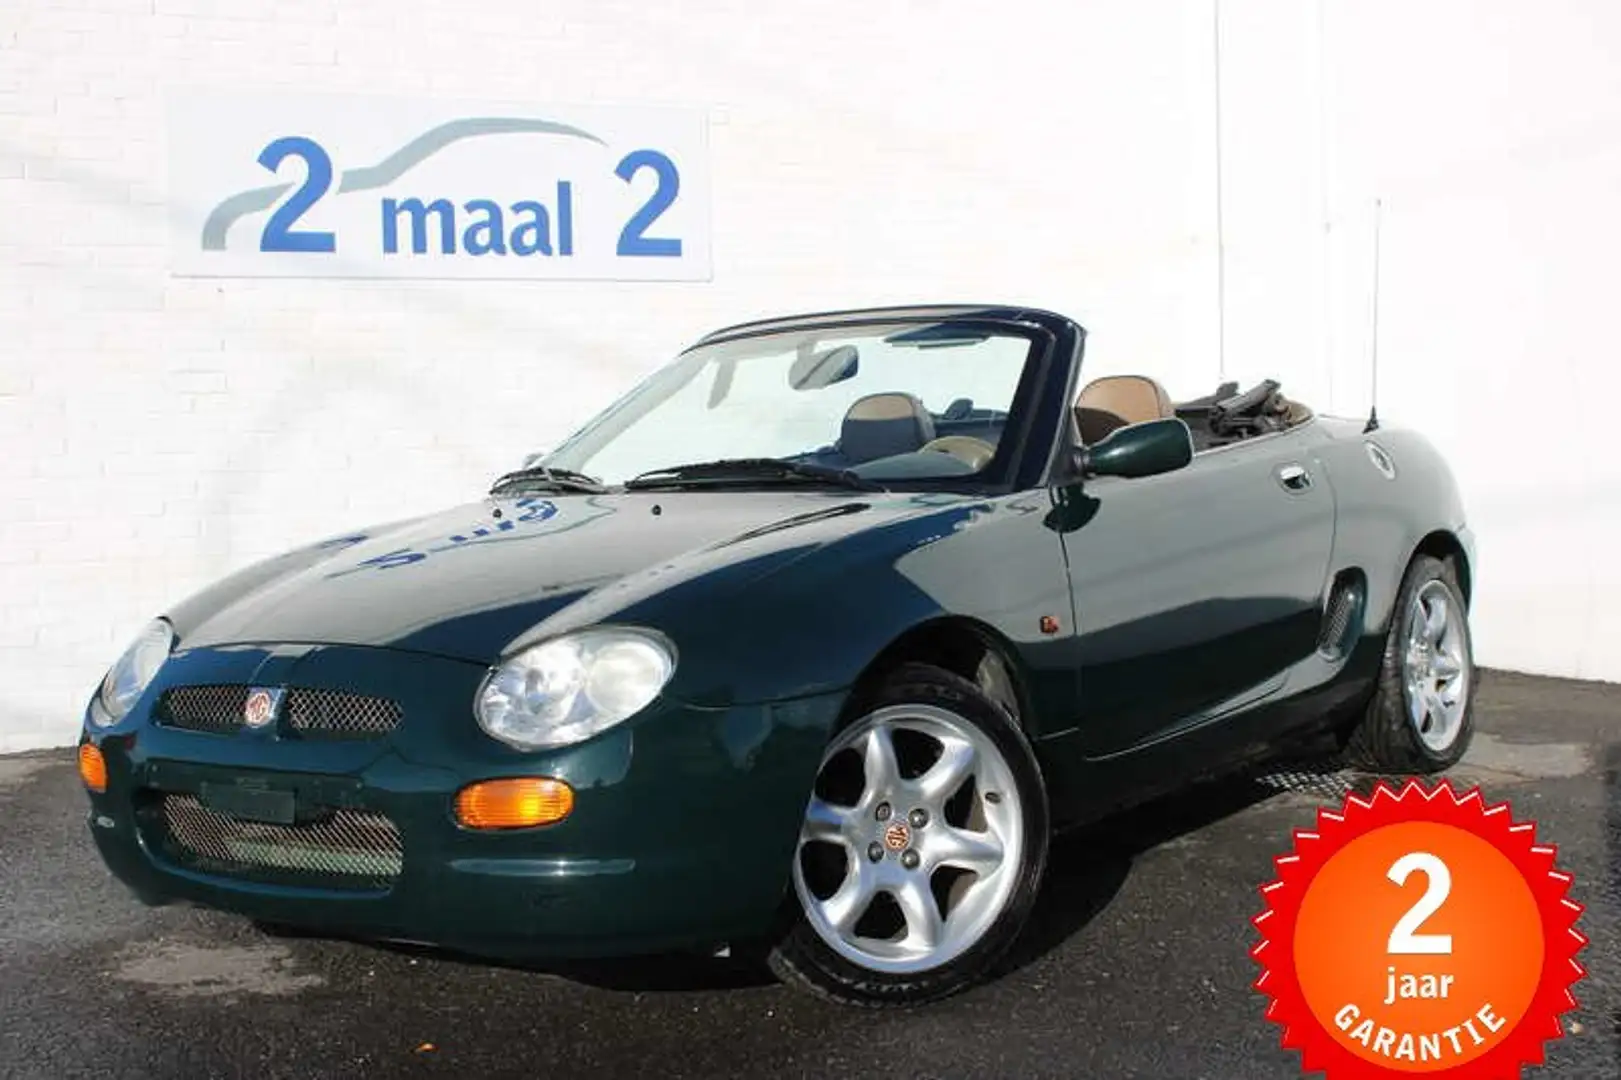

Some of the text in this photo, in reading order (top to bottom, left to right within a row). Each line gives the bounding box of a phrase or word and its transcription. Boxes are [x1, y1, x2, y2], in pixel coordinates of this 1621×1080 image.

[257, 136, 682, 257] 2 maal 2
